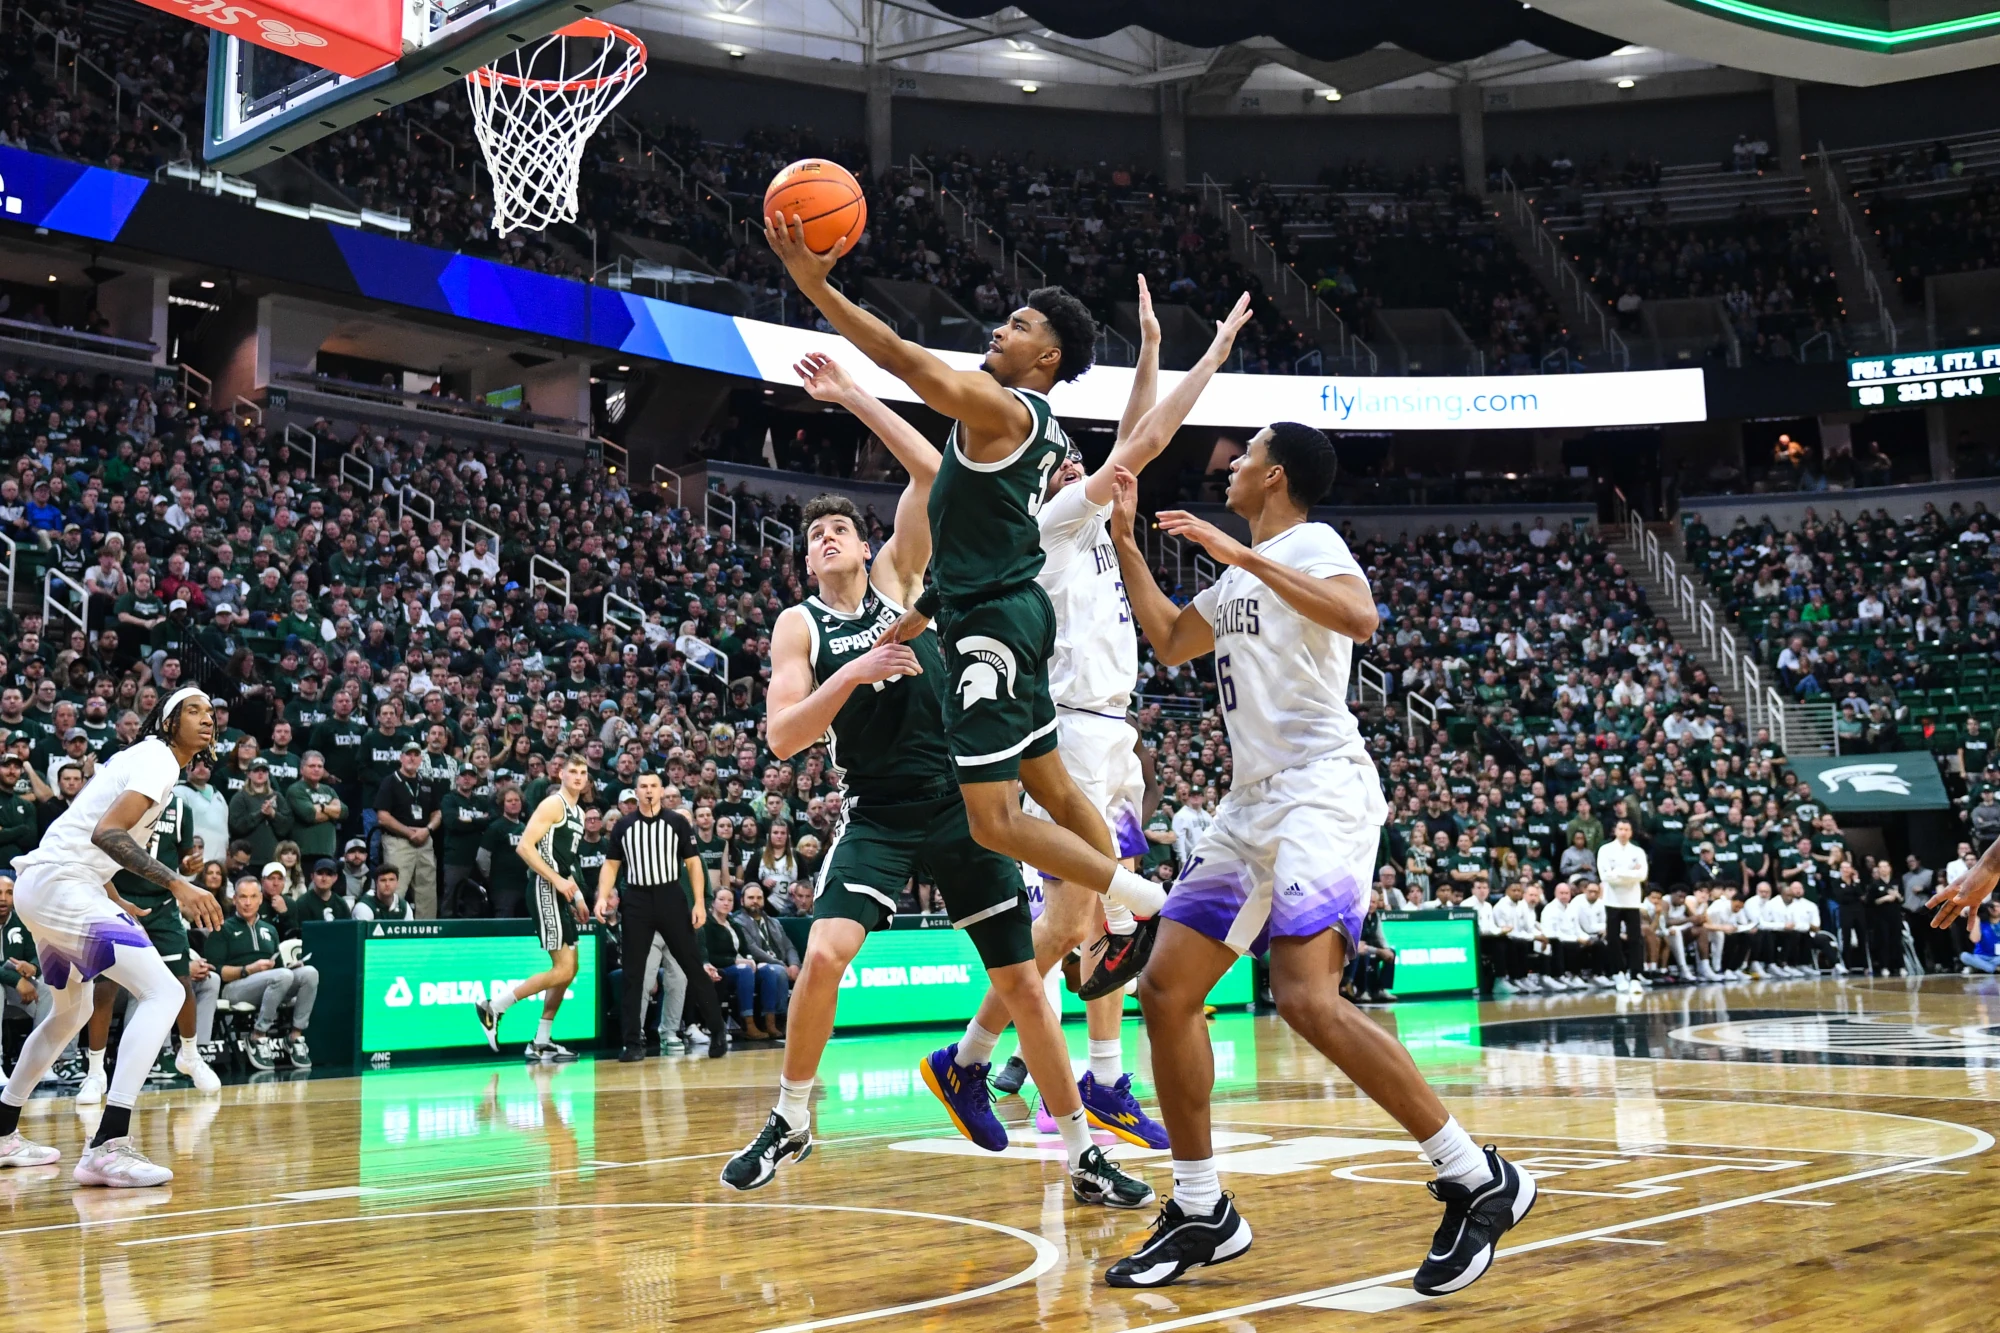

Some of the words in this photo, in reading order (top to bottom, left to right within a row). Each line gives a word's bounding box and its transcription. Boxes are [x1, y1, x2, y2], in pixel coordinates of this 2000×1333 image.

[1320, 385, 1538, 420] flylansing.com
[1028, 451, 1057, 516] 3
[1217, 652, 1237, 713] 6
[387, 926, 439, 934] ACRISURE
[861, 967, 909, 987] DELTA
[910, 964, 971, 985] DENTAL
[419, 980, 486, 1006] DELTA
